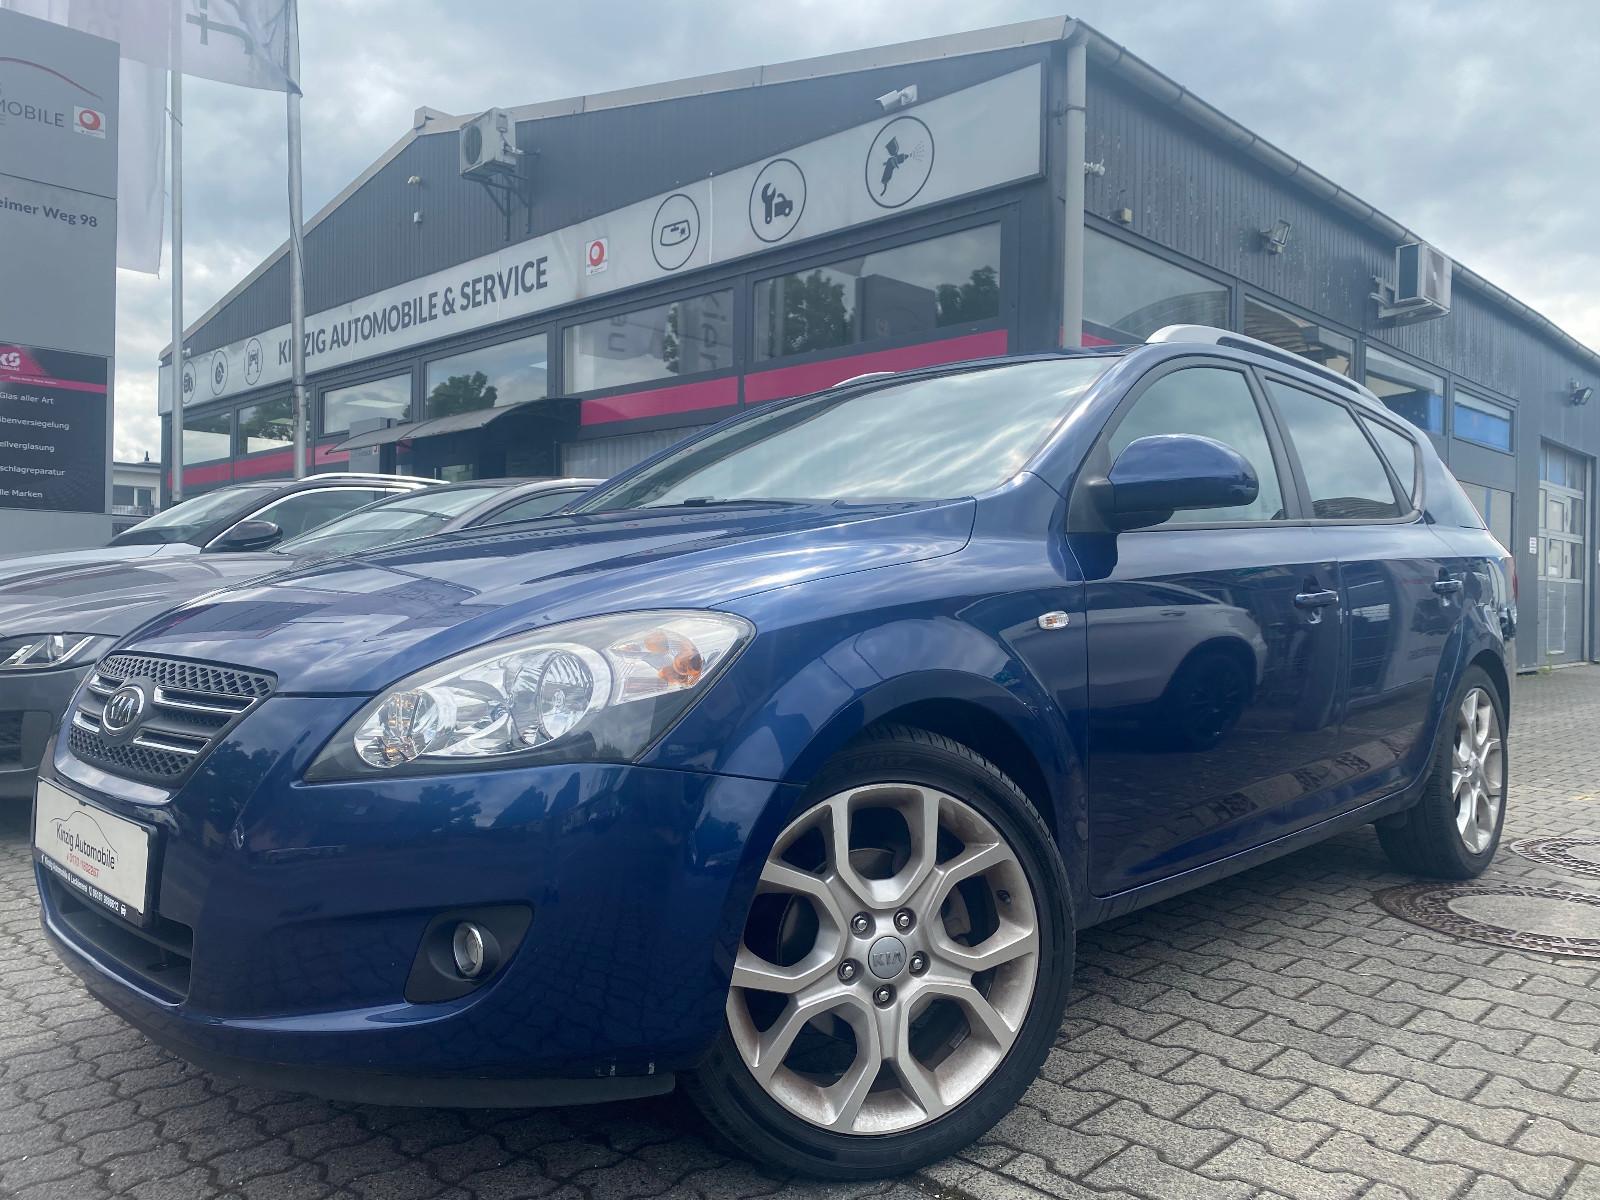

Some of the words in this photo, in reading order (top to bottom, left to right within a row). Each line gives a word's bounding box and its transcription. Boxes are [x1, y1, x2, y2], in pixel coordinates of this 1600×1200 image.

[42, 205, 77, 226] Weg
[79, 214, 98, 228] 98
[278, 329, 326, 366] KIZIG
[329, 291, 438, 351] AUTOMOBILE
[442, 286, 457, 316] &
[459, 255, 549, 312] SERVICE
[20, 394, 39, 402] aller
[41, 396, 54, 405] Art
[11, 489, 43, 499] Marken
[56, 821, 74, 852] Kinzig
[75, 833, 115, 870] Automobile
[872, 951, 902, 968] KIA
